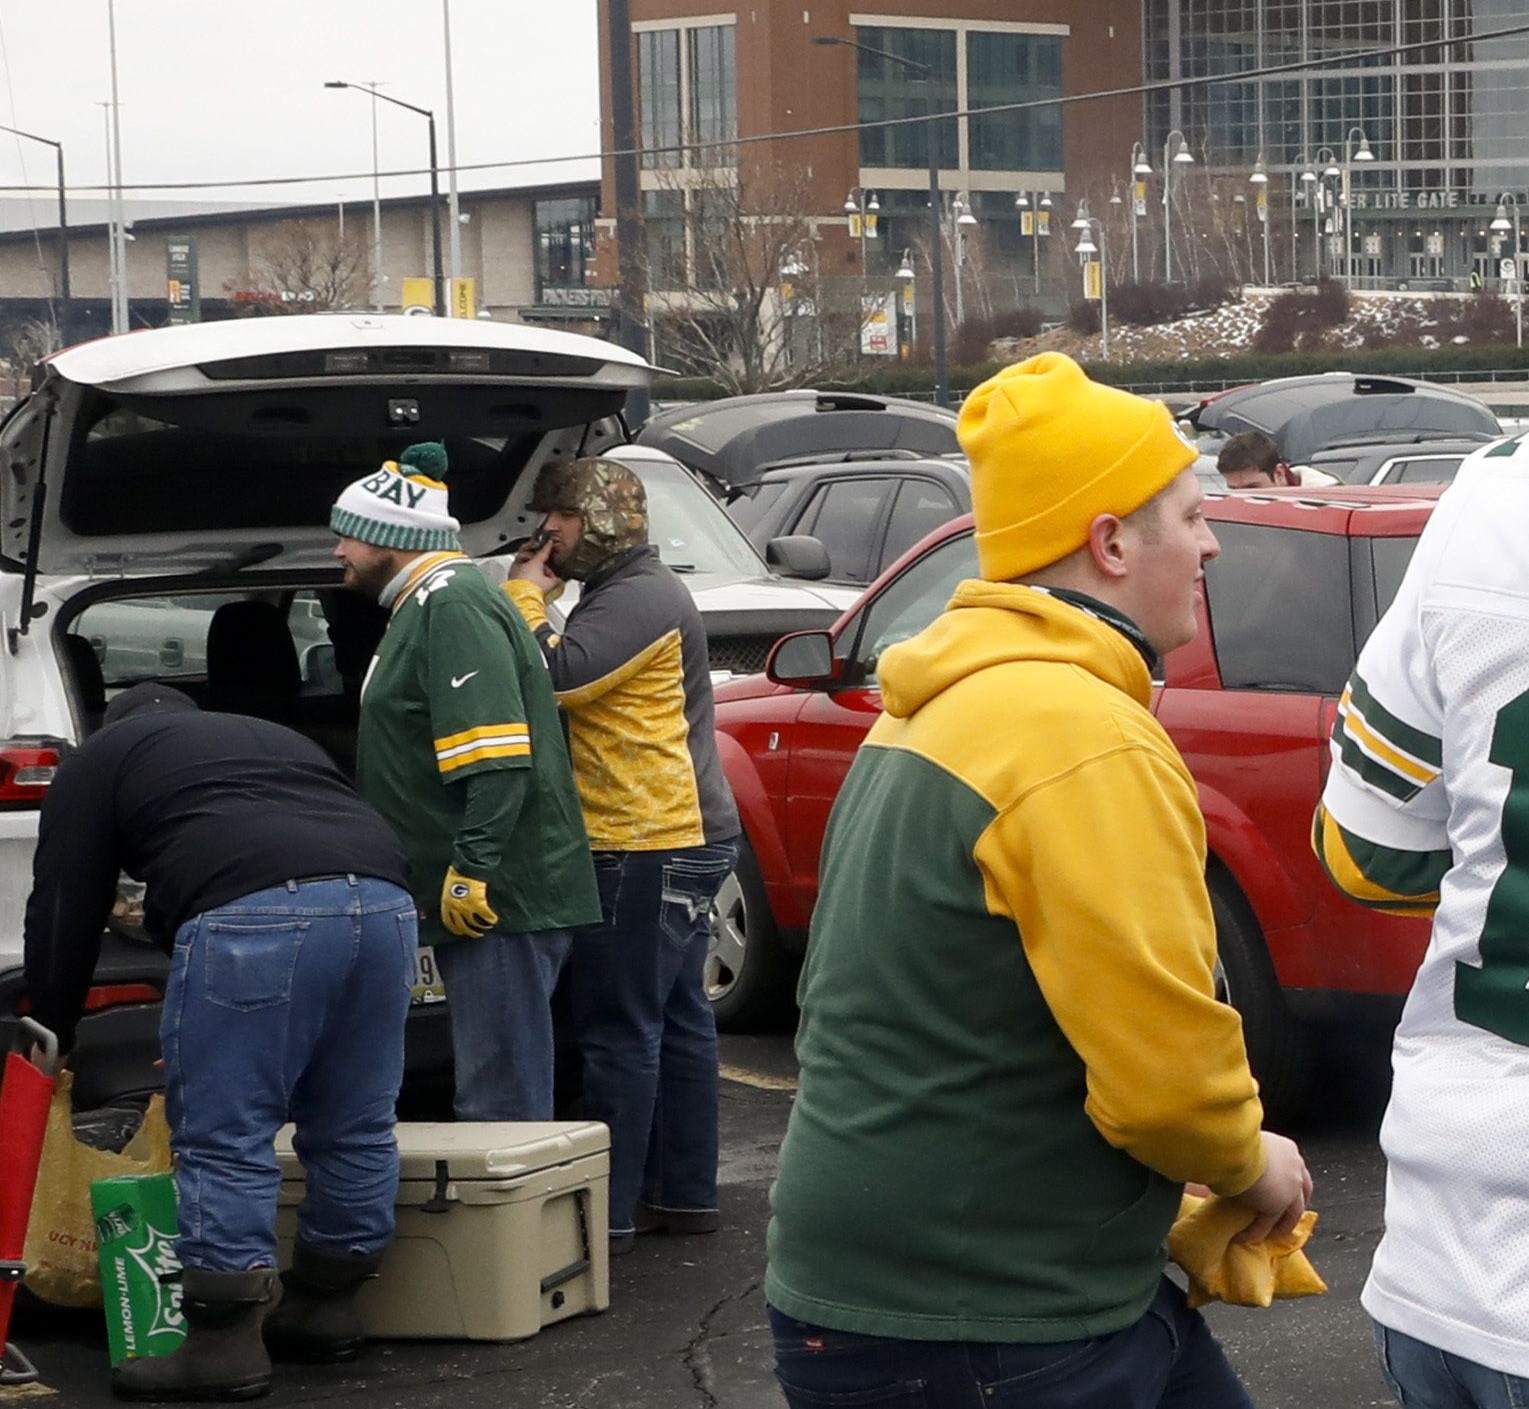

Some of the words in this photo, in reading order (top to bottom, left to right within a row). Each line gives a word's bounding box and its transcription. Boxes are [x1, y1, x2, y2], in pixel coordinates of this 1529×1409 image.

[1375, 192, 1411, 209] LITE
[1418, 191, 1458, 208] GATE
[361, 470, 428, 509] BAY
